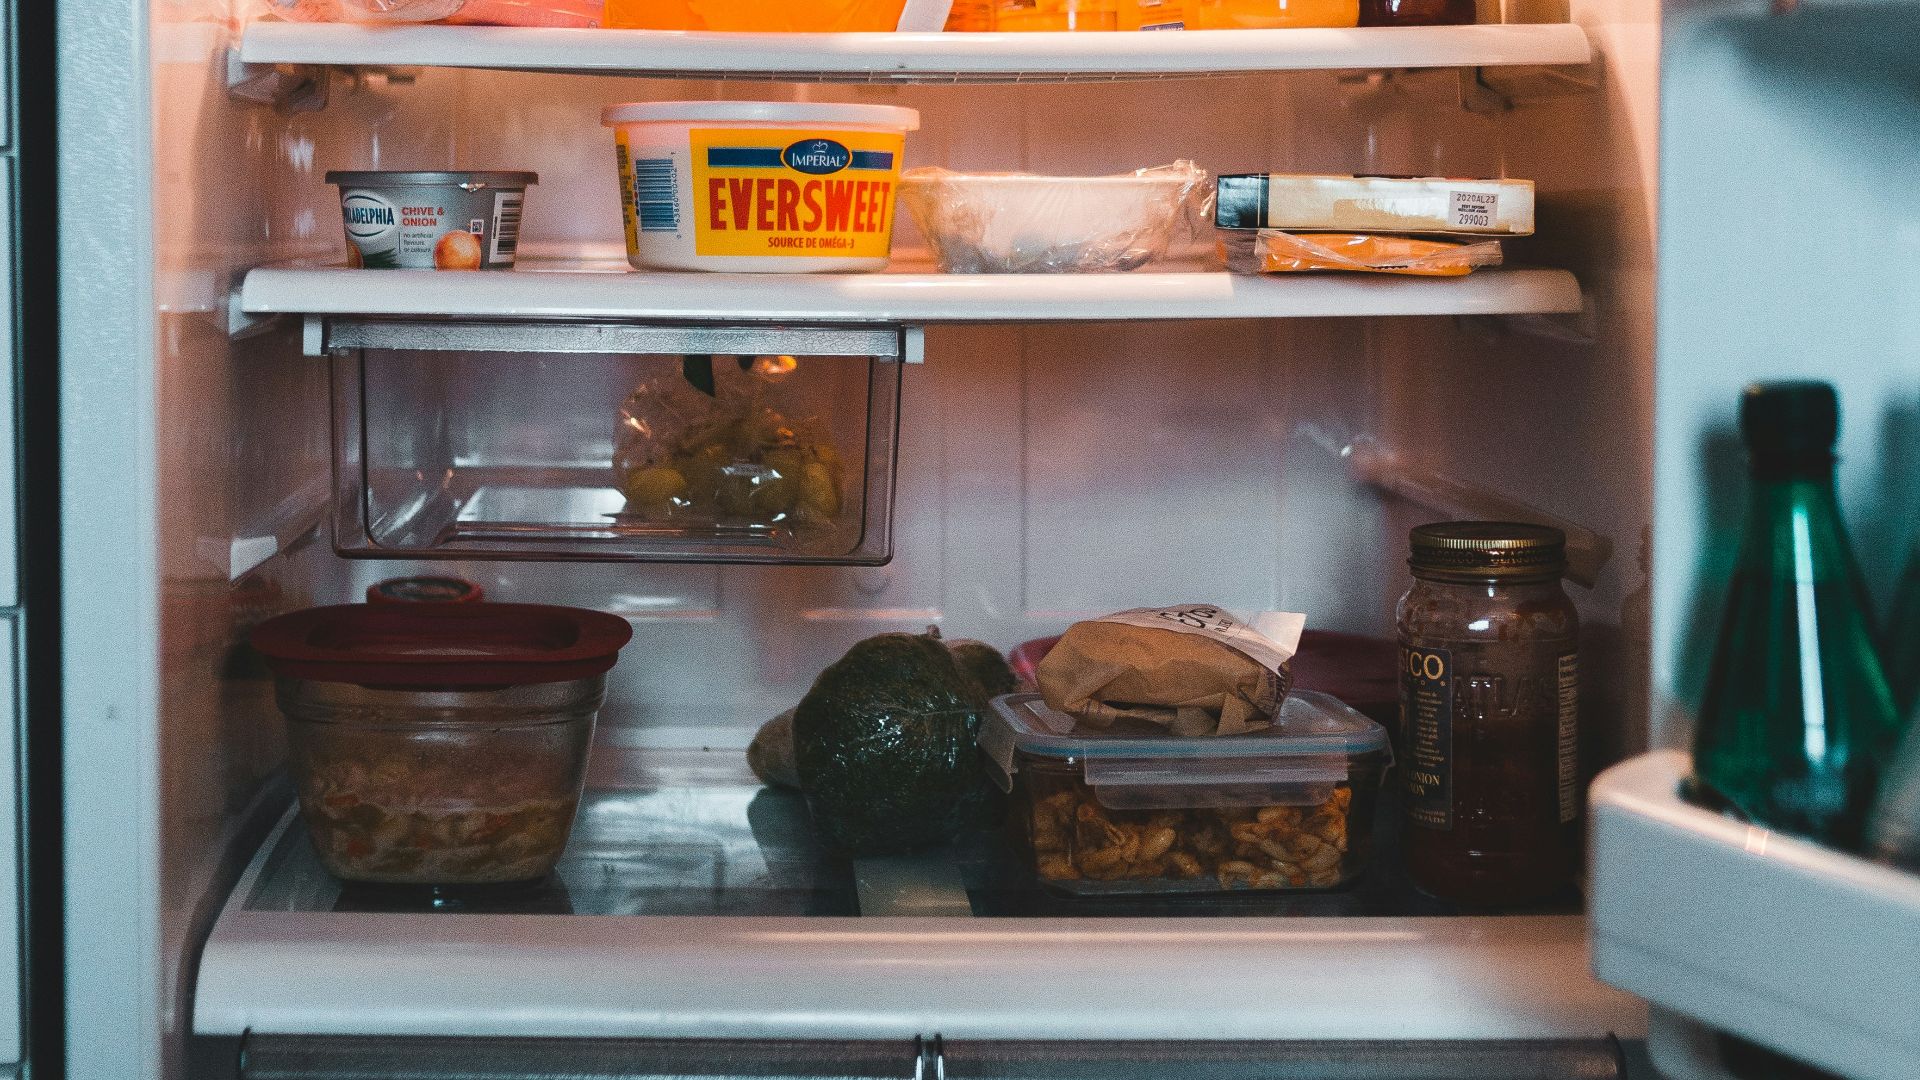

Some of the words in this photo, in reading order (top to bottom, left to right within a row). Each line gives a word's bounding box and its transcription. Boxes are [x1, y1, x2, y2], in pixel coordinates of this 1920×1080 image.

[792, 152, 842, 167] IMPERIAL
[1457, 194, 1496, 204] 2020AL23
[401, 206, 434, 216] CHIVE
[436, 206, 445, 217] &
[708, 178, 890, 233] EVERSWEET
[402, 218, 437, 227] ONION
[1459, 214, 1488, 226] 299003
[768, 236, 804, 248] SOURCE
[805, 237, 817, 248] DE
[819, 236, 854, 249] OMÉGA-3
